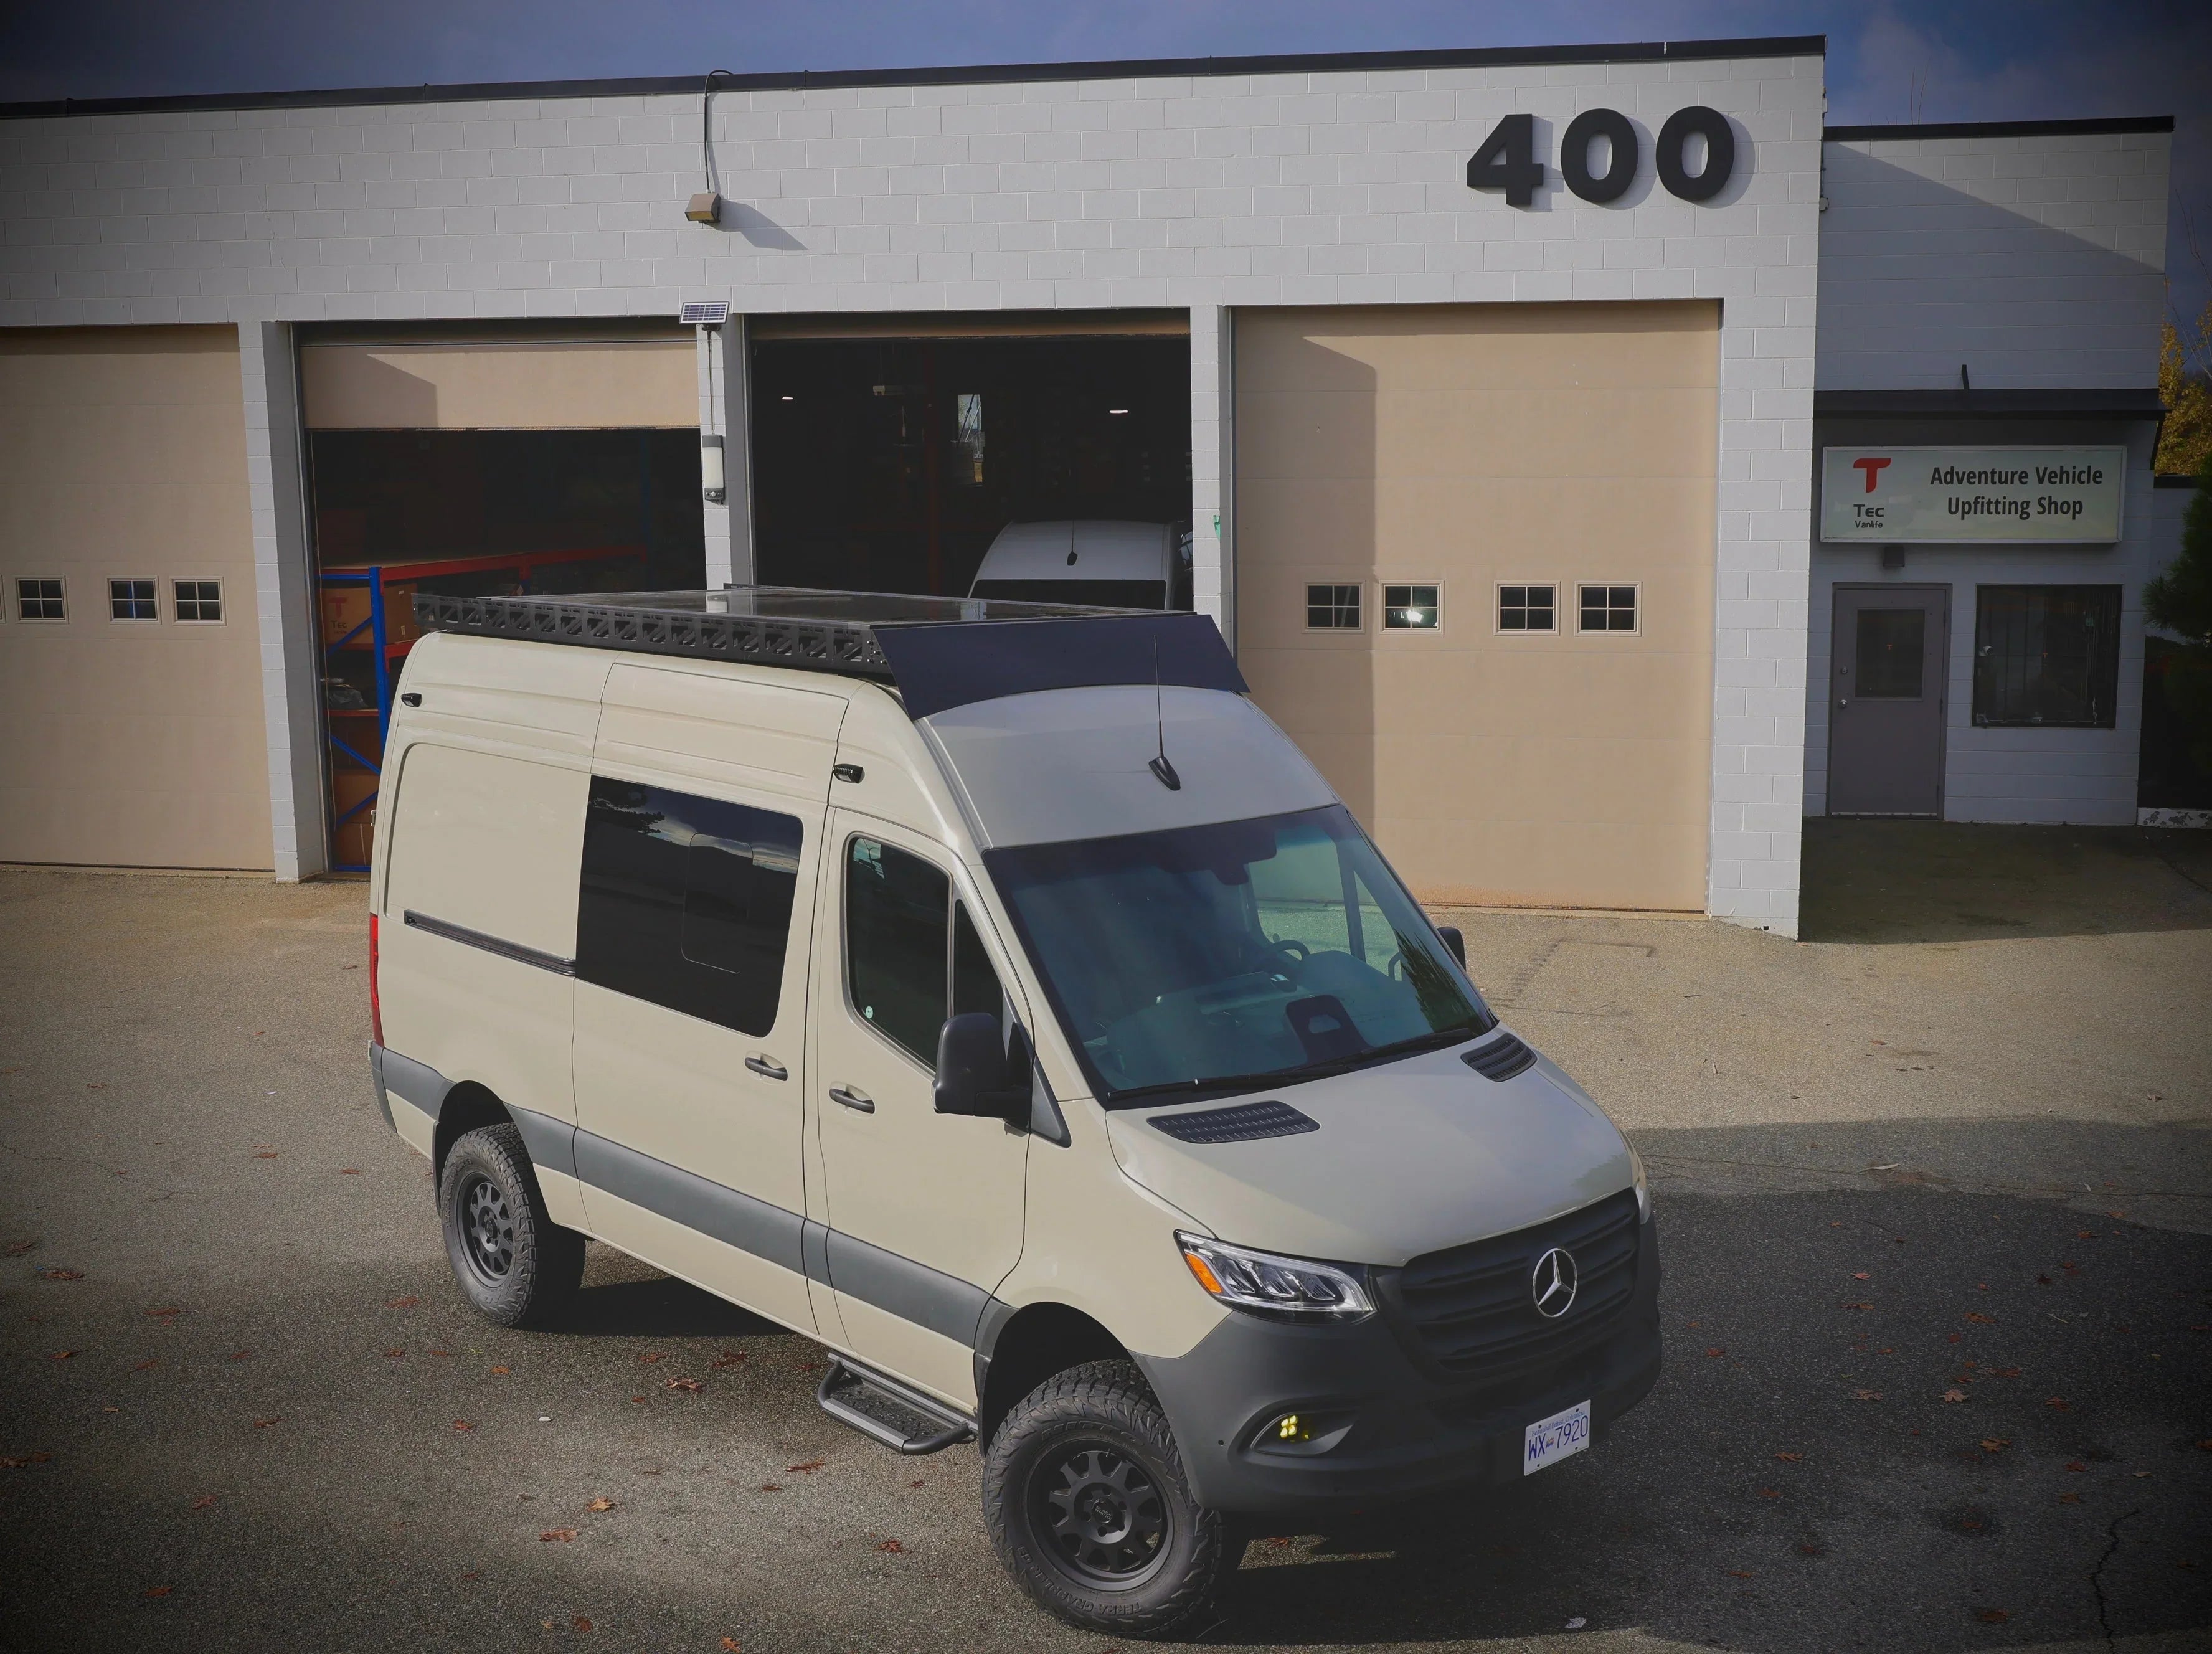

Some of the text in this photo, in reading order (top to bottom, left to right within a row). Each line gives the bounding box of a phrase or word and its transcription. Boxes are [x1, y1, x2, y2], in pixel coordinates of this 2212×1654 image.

[1467, 105, 1735, 206] 400
[1931, 466, 2103, 485] Adventure Vehicle
[1947, 496, 2083, 521] Upfitting Shop
[1855, 520, 1883, 529] Vanlife
[1528, 1415, 1588, 1461] WX 7920
[1097, 1601, 1143, 1615] TERRA
